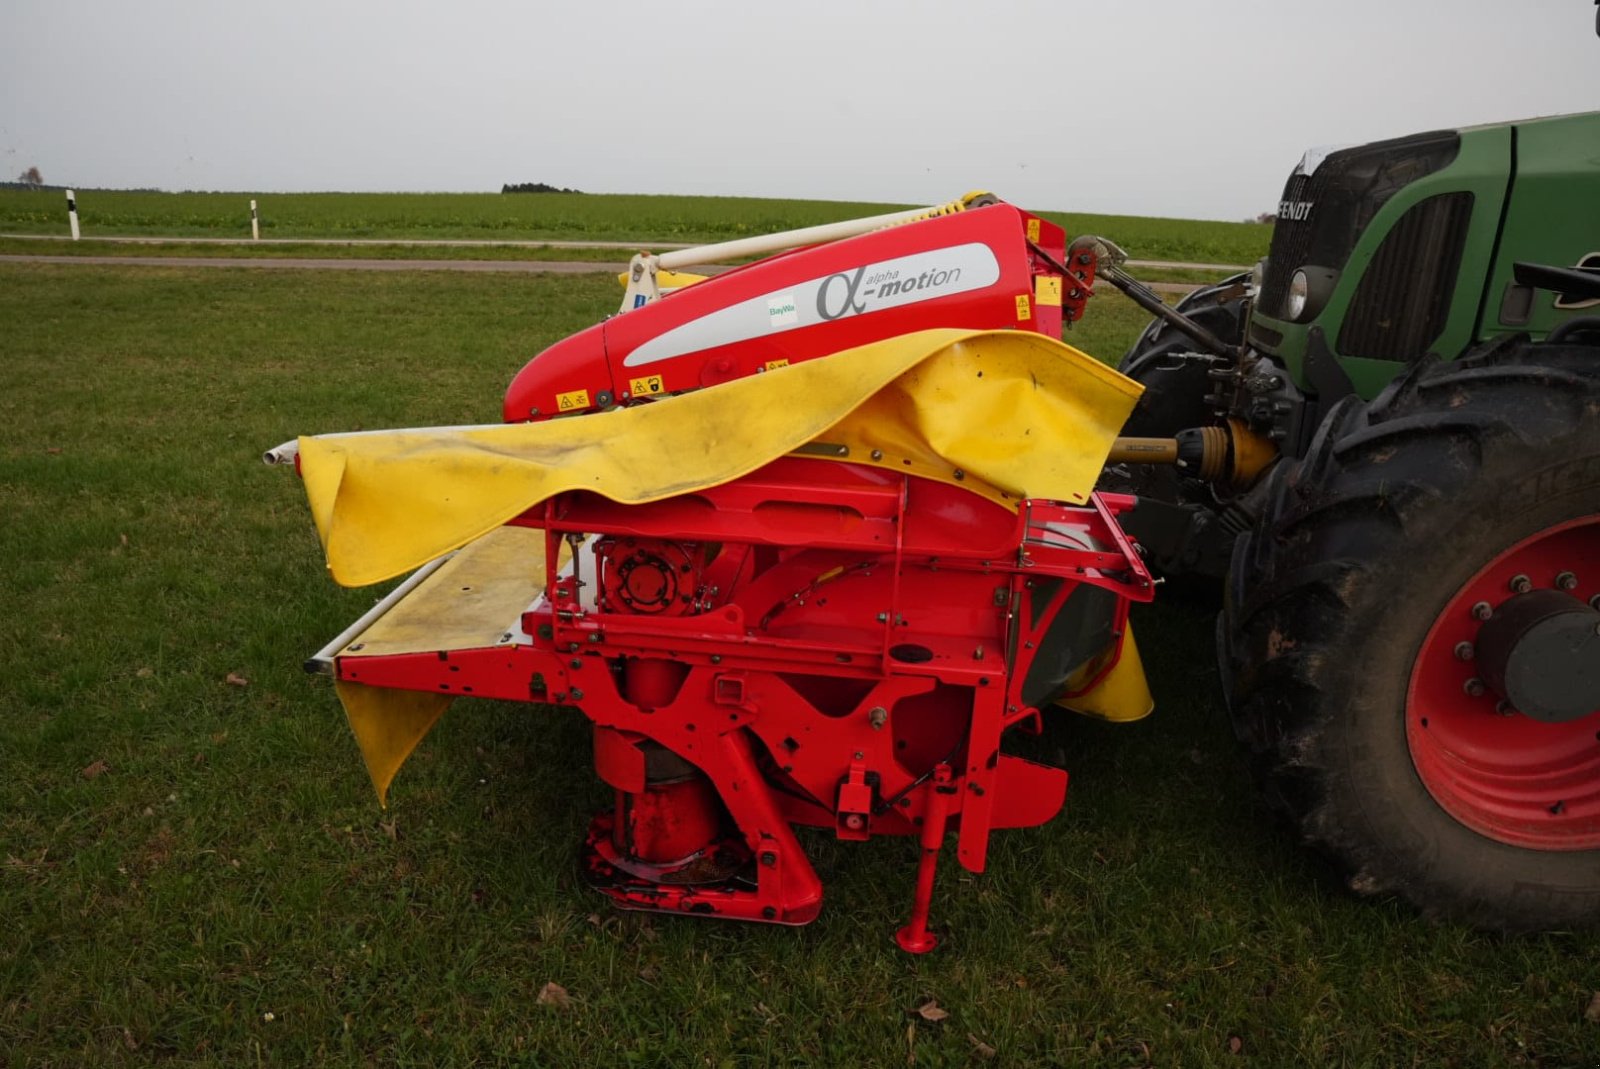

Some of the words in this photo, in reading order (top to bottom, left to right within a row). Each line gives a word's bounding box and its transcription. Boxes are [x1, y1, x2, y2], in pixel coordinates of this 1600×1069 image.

[1277, 201, 1314, 221] FENDT
[866, 269, 899, 285] alpha
[769, 304, 795, 316] BayWa
